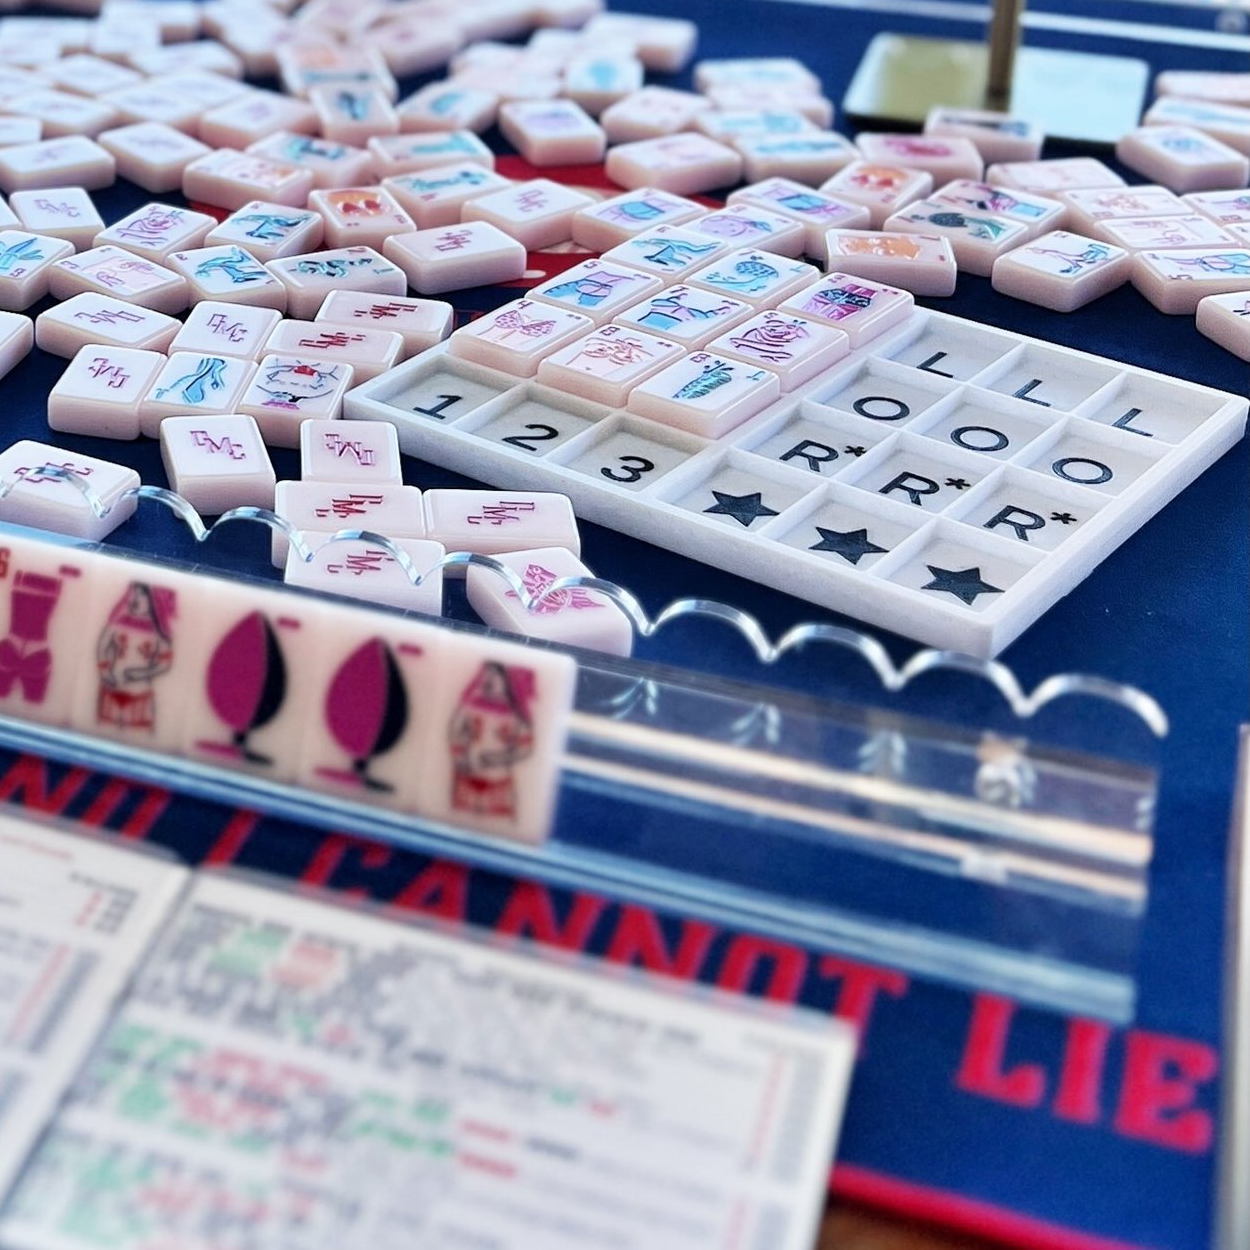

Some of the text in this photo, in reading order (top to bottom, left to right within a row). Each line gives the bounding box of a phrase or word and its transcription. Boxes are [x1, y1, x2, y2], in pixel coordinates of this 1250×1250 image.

[413, 394, 654, 483] 1 2 3
[917, 352, 1154, 437] L L L
[853, 396, 1113, 484] O O O
[955, 990, 1221, 1155] LIE
